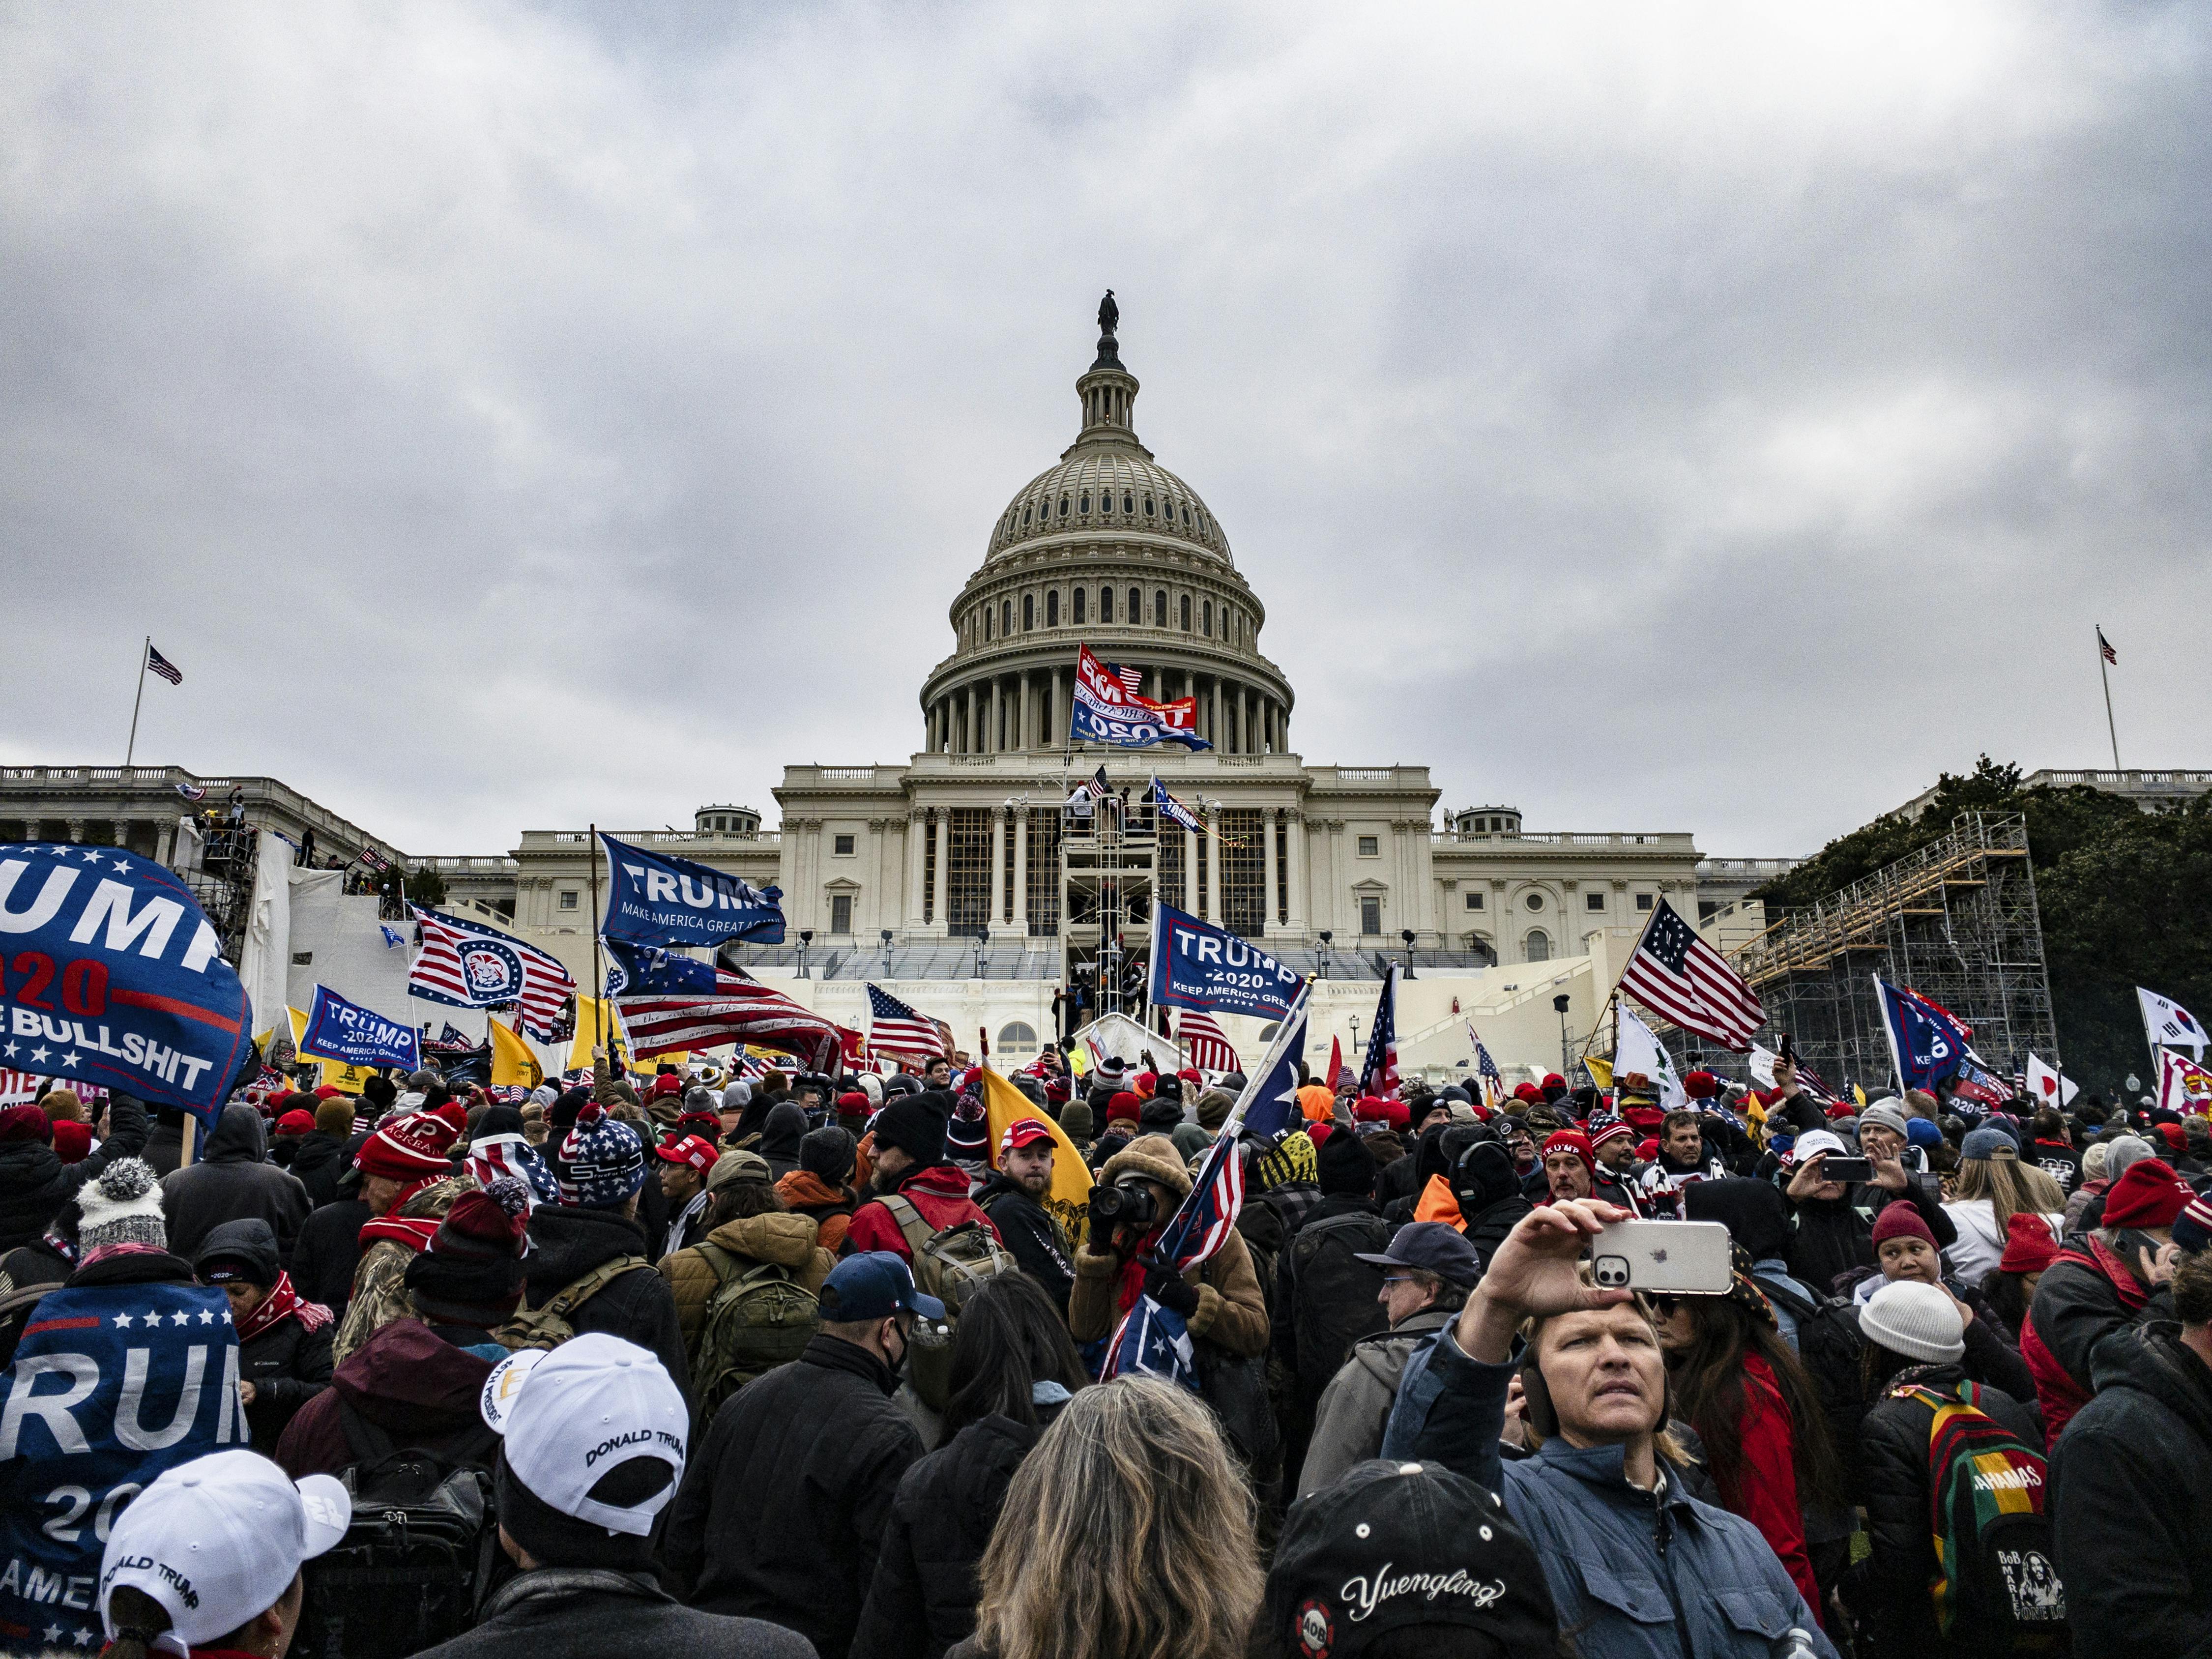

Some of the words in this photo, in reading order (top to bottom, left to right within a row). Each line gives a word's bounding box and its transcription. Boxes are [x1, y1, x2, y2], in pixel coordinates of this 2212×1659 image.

[622, 902, 650, 921] MAKE
[652, 913, 703, 930] AMERICA
[707, 920, 744, 932] GREAT
[1176, 929, 1296, 984] TRUMP
[0, 951, 109, 1017] 20
[1173, 981, 1203, 995] KEEP
[1206, 986, 1258, 1000] AMERICA
[1262, 994, 1292, 1011] GREA
[1206, 968, 1273, 989] -2020-
[327, 1000, 411, 1049] TRUMP
[649, 1037, 674, 1046] bear
[11, 1007, 213, 1091] BULLSHIT
[317, 1038, 338, 1049] KEEP
[340, 1046, 377, 1054] AMERICA
[1543, 1144, 1579, 1158] TRUMP
[484, 1385, 501, 1425] PRESIDENT
[586, 1430, 652, 1468] DONALD
[0, 1558, 100, 1612] AME
[159, 1563, 199, 1610] TRUMP
[1341, 1562, 1506, 1622] Yuengling
